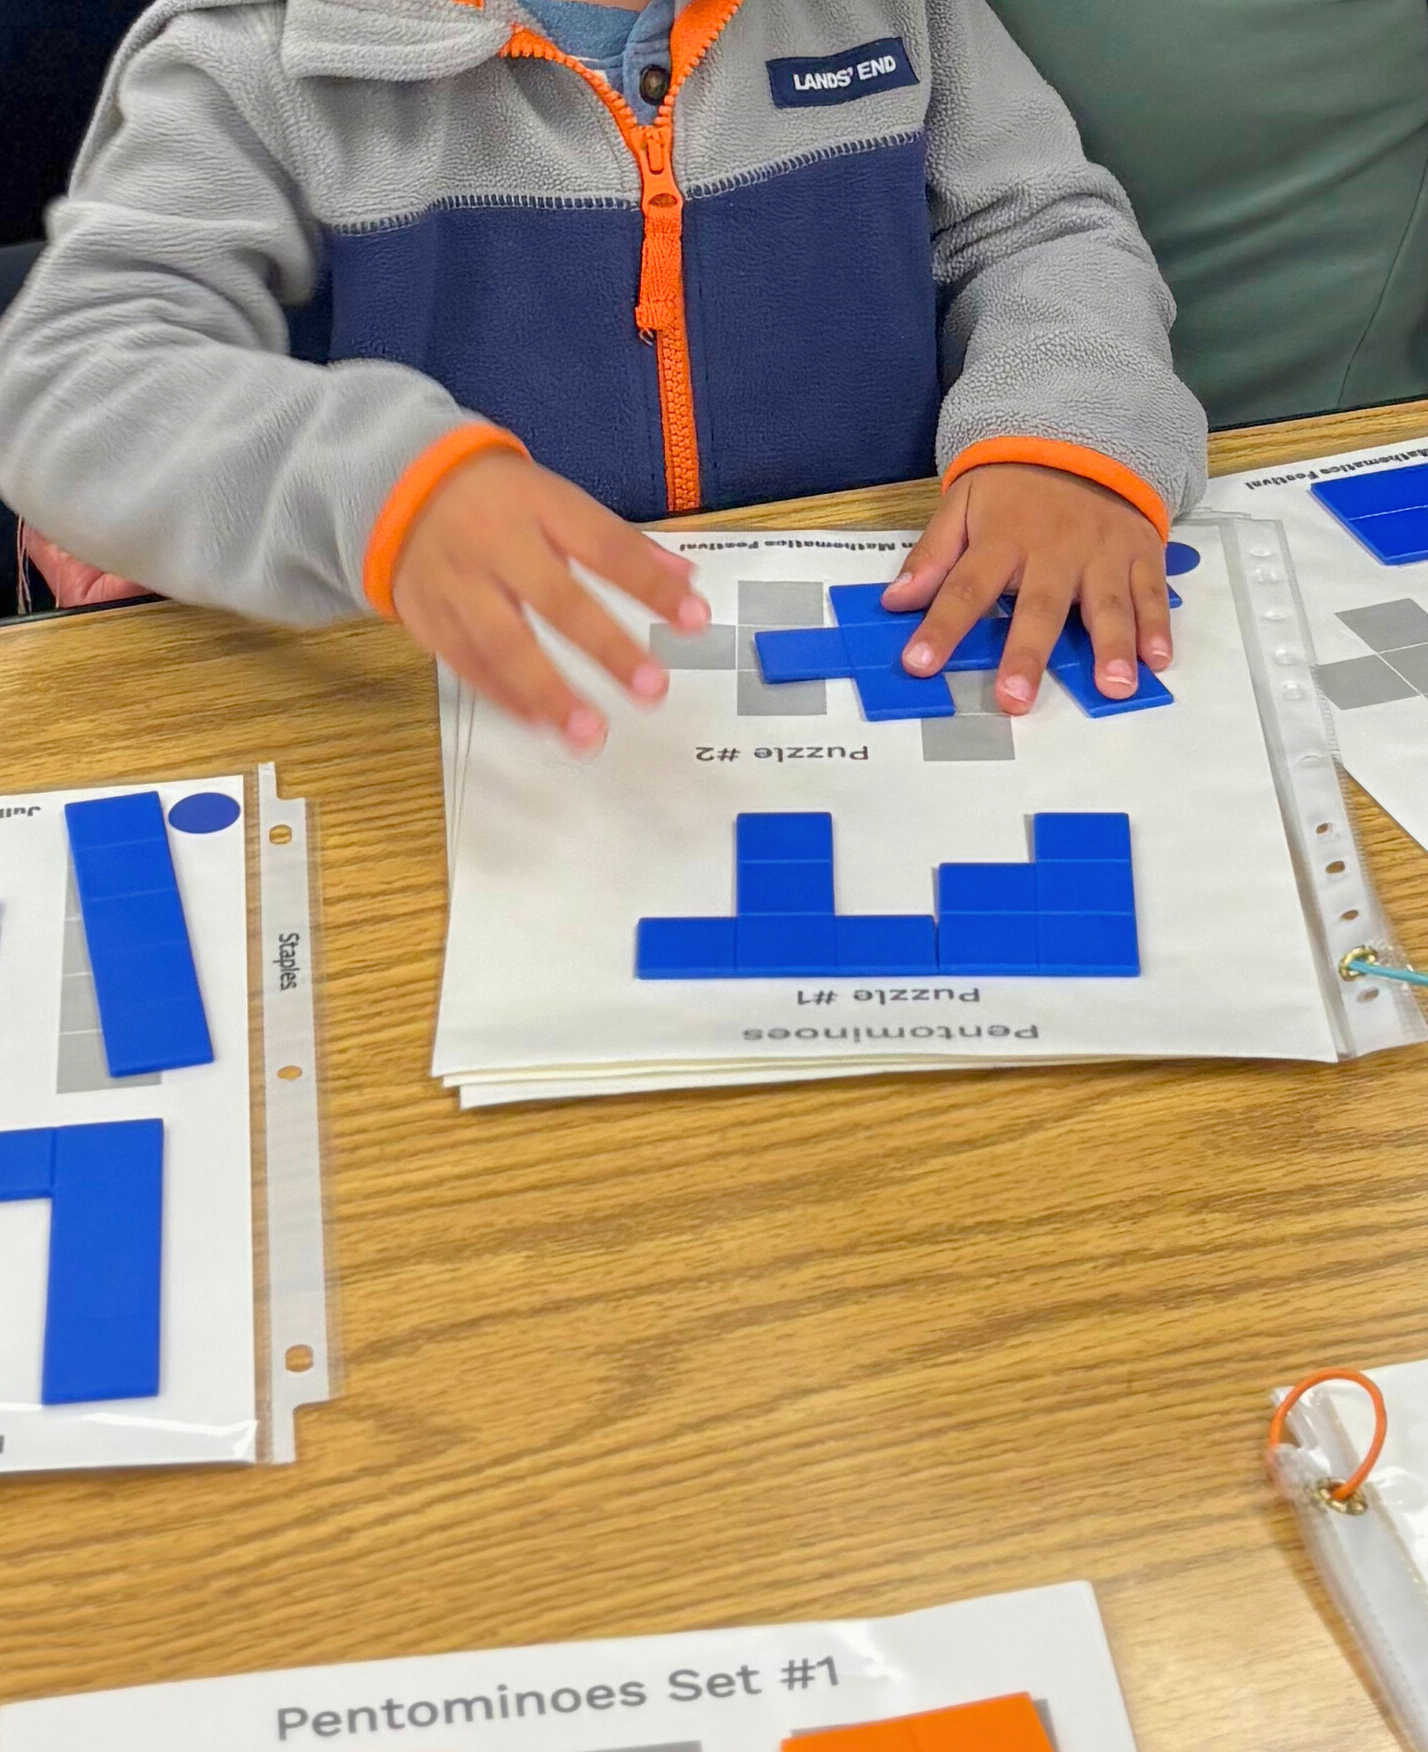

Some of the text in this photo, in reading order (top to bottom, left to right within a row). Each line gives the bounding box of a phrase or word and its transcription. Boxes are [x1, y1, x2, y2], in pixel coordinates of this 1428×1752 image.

[857, 54, 897, 81] END
[695, 744, 870, 762] Puzzle #2
[272, 932, 301, 991] Staples
[796, 987, 981, 1006] Puzzle #1
[742, 1023, 1039, 1045] Pentominoes
[275, 1655, 840, 1741] Pentominoes Set #1
